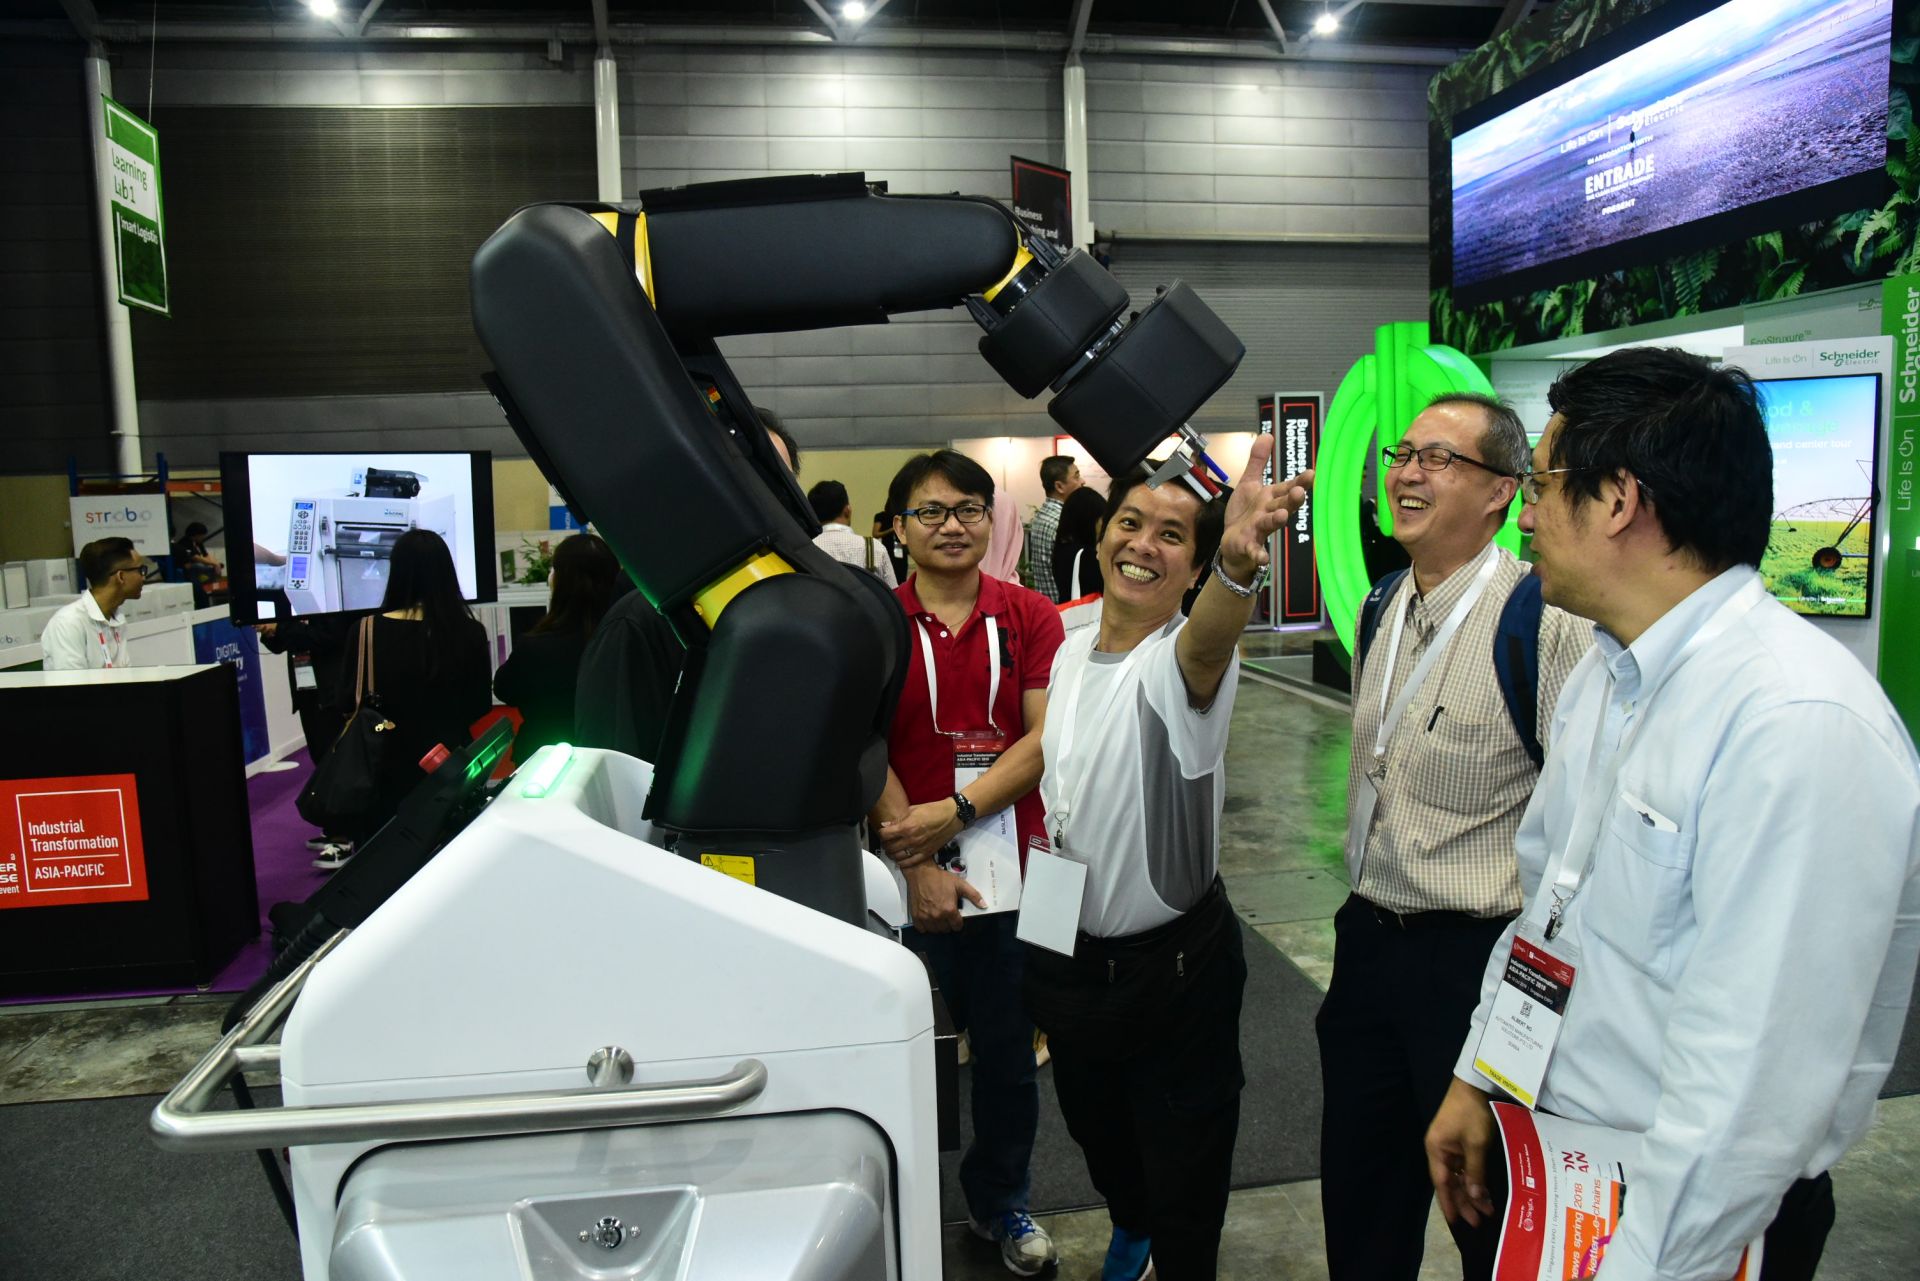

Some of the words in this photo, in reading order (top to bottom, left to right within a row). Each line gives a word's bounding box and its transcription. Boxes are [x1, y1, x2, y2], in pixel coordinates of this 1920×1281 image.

[112, 148, 148, 191] Learning
[1585, 153, 1655, 195] ENTRADE
[114, 175, 128, 200] Lab
[130, 186, 136, 204] 1
[1602, 198, 1635, 215] PRESENT
[1899, 286, 1920, 403] Schneider
[1819, 349, 1880, 365] Schneider
[1898, 428, 1914, 457] On
[1898, 460, 1913, 475] Is
[1897, 480, 1912, 511] Life
[1298, 533, 1310, 544] &
[216, 642, 240, 660] DIGITAL
[28, 819, 85, 836] Industrial
[30, 835, 119, 852] Transformation
[10, 853, 16, 861] a
[0, 863, 17, 872] ER
[35, 863, 105, 880] ASIA-PACIFIC
[0, 874, 18, 883] SE
[1573, 1183, 1583, 1209] 2018
[1573, 1212, 1584, 1248] spring
